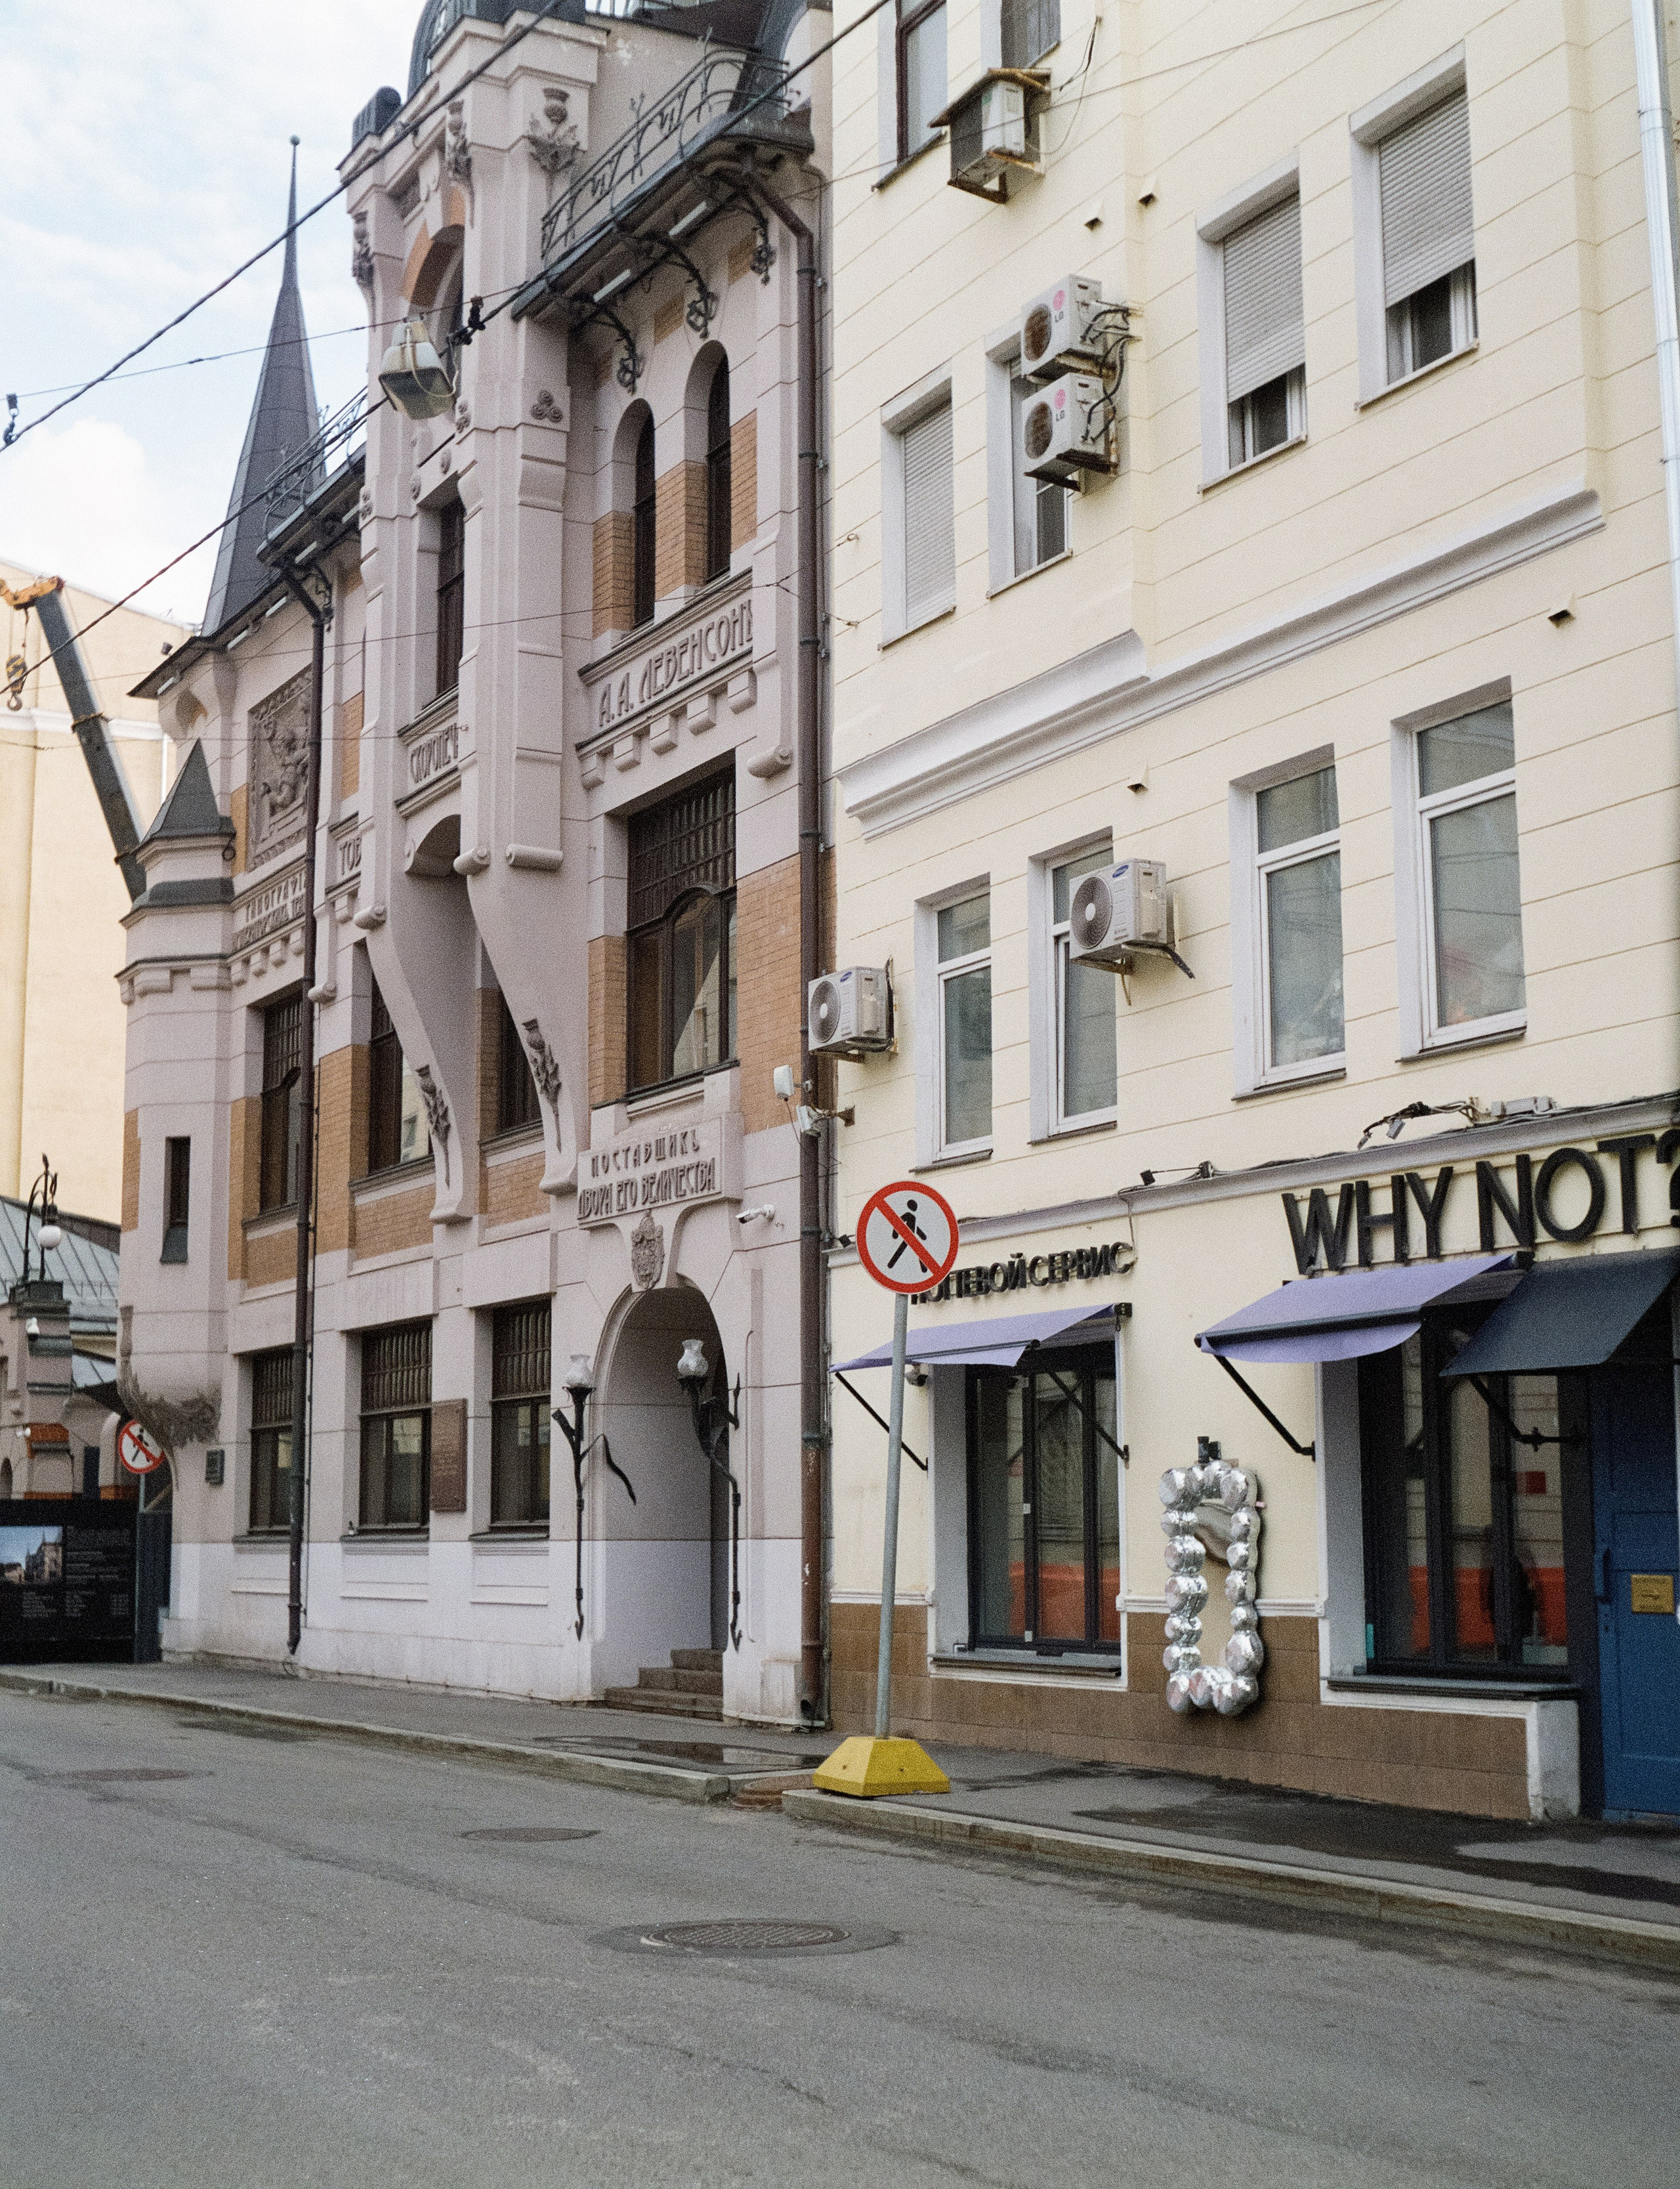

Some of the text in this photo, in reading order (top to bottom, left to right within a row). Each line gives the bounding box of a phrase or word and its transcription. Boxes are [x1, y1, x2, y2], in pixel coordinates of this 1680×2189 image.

[1055, 310, 1064, 323] LG
[1055, 410, 1065, 422] LG
[616, 1177, 639, 1212] ЕГО
[642, 1157, 716, 1206] ВЕЛИЧЕСТВА
[1282, 1166, 1454, 1276] WHY
